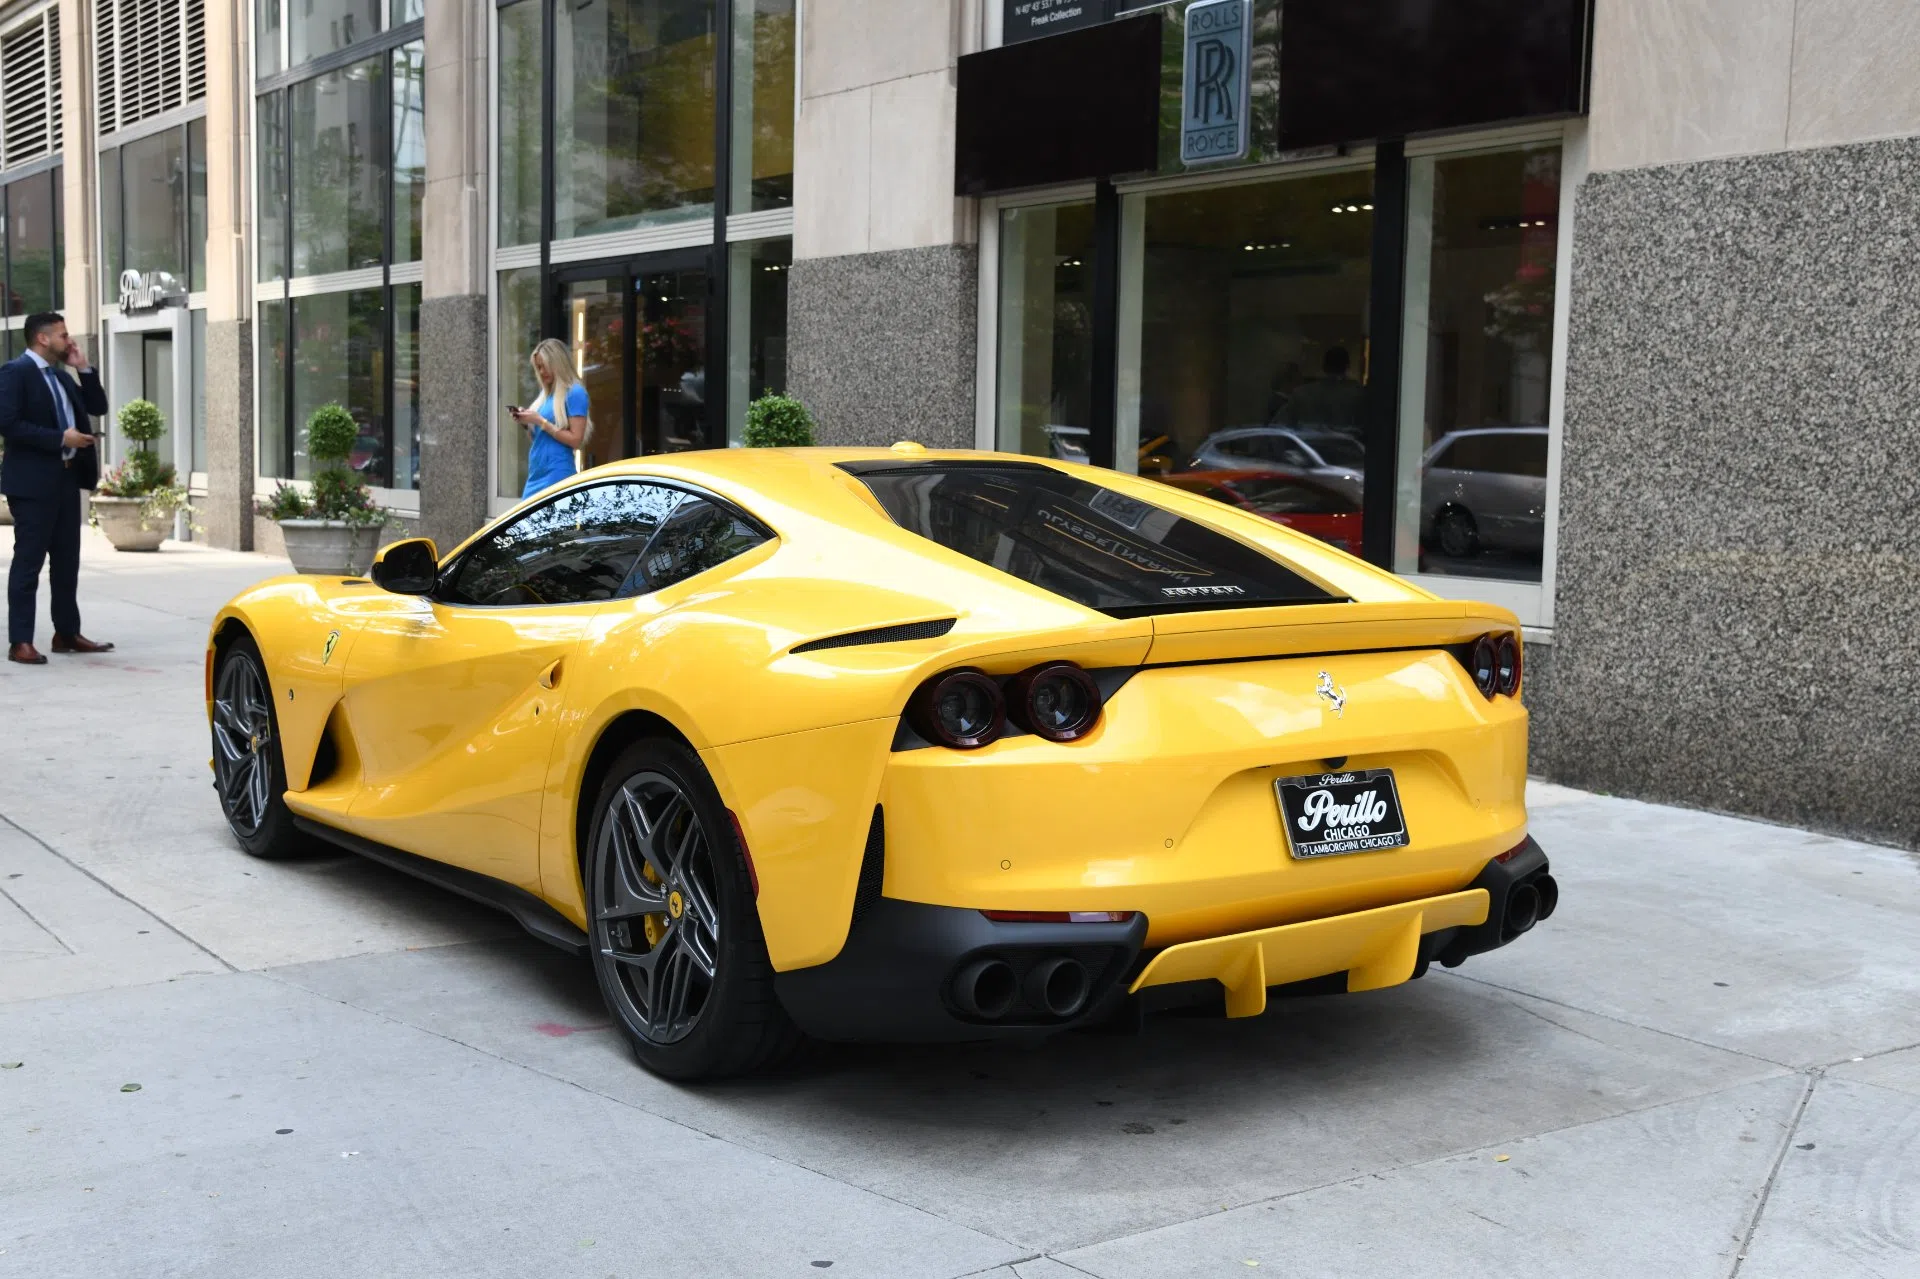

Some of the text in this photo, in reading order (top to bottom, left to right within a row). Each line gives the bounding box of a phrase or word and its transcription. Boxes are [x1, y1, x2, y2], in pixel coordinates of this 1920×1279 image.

[1031, 7, 1082, 26] Freak Collection
[1191, 5, 1239, 31] ROLLS
[1187, 130, 1235, 153] ROYCE
[1318, 773, 1355, 786] Perillo
[1297, 789, 1387, 831] Perillo
[1323, 824, 1370, 841] CHICAGO
[1308, 836, 1394, 855] LAMBORGHINI CHICAGO
